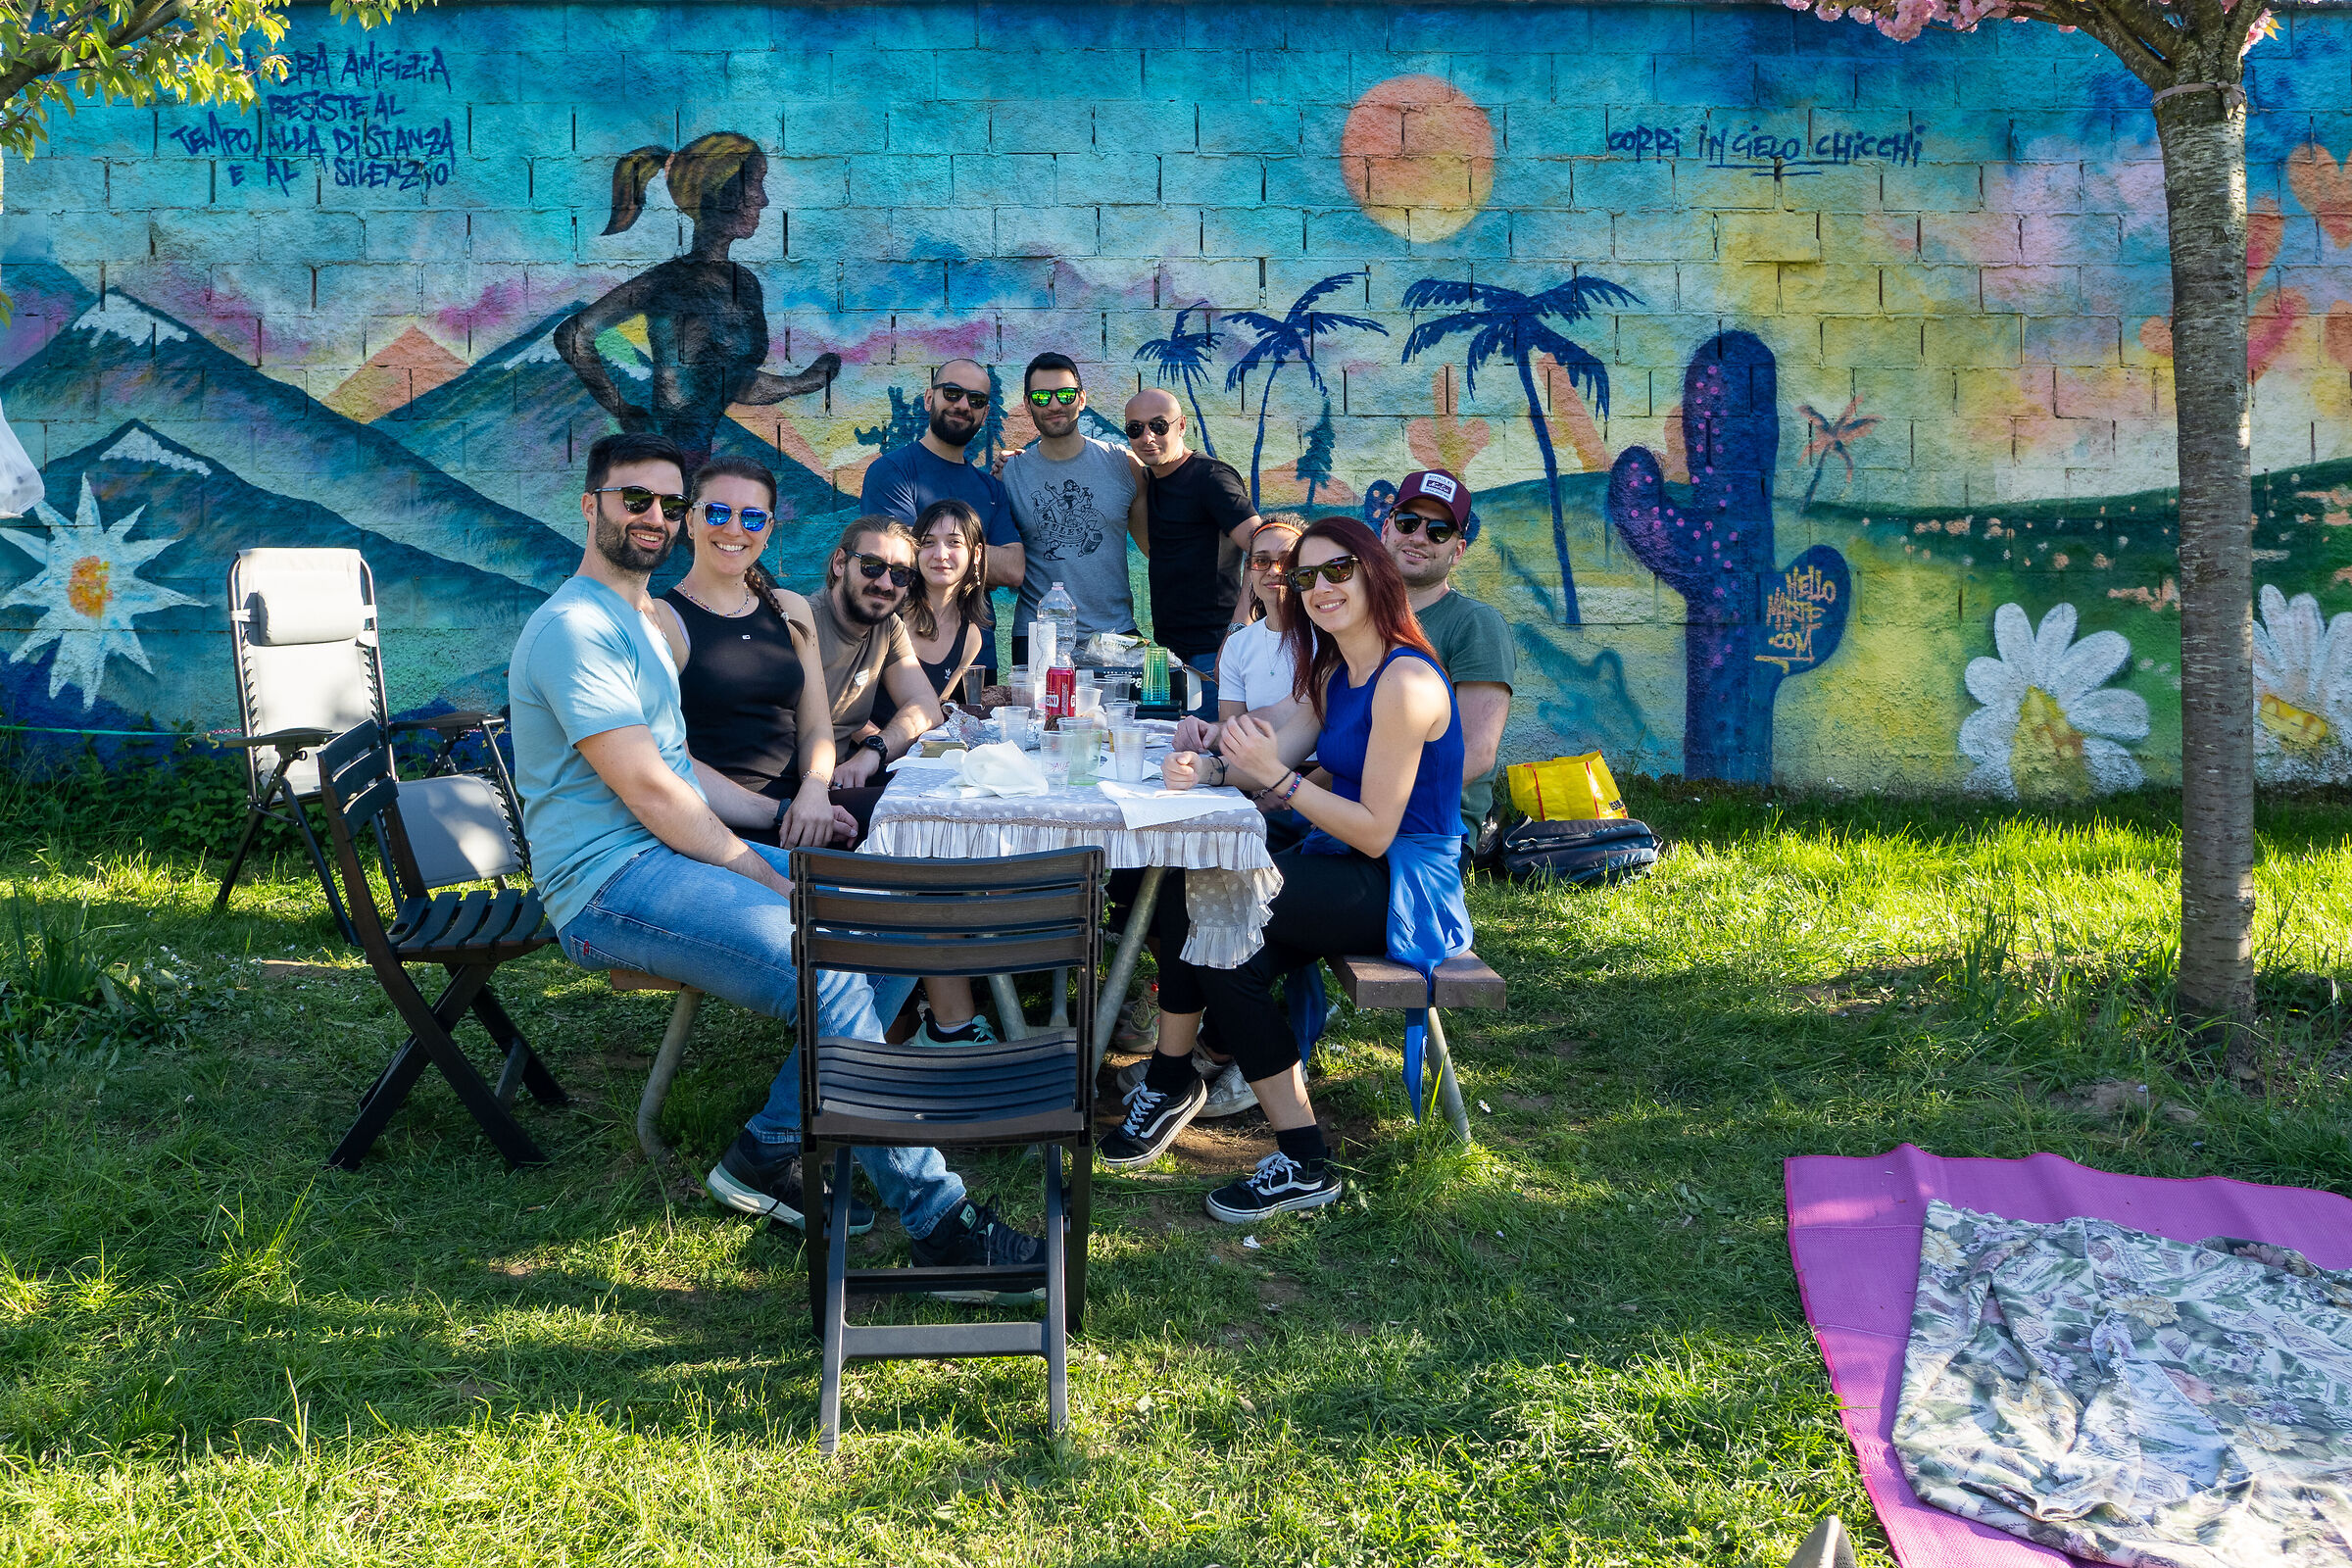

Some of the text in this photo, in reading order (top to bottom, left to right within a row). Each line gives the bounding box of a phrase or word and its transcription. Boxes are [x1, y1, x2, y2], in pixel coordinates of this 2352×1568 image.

[373, 91, 407, 124] AL
[266, 123, 328, 173] ALLA
[227, 164, 244, 187] E
[266, 157, 301, 197] AL
[1766, 587, 1826, 632] MARTE
